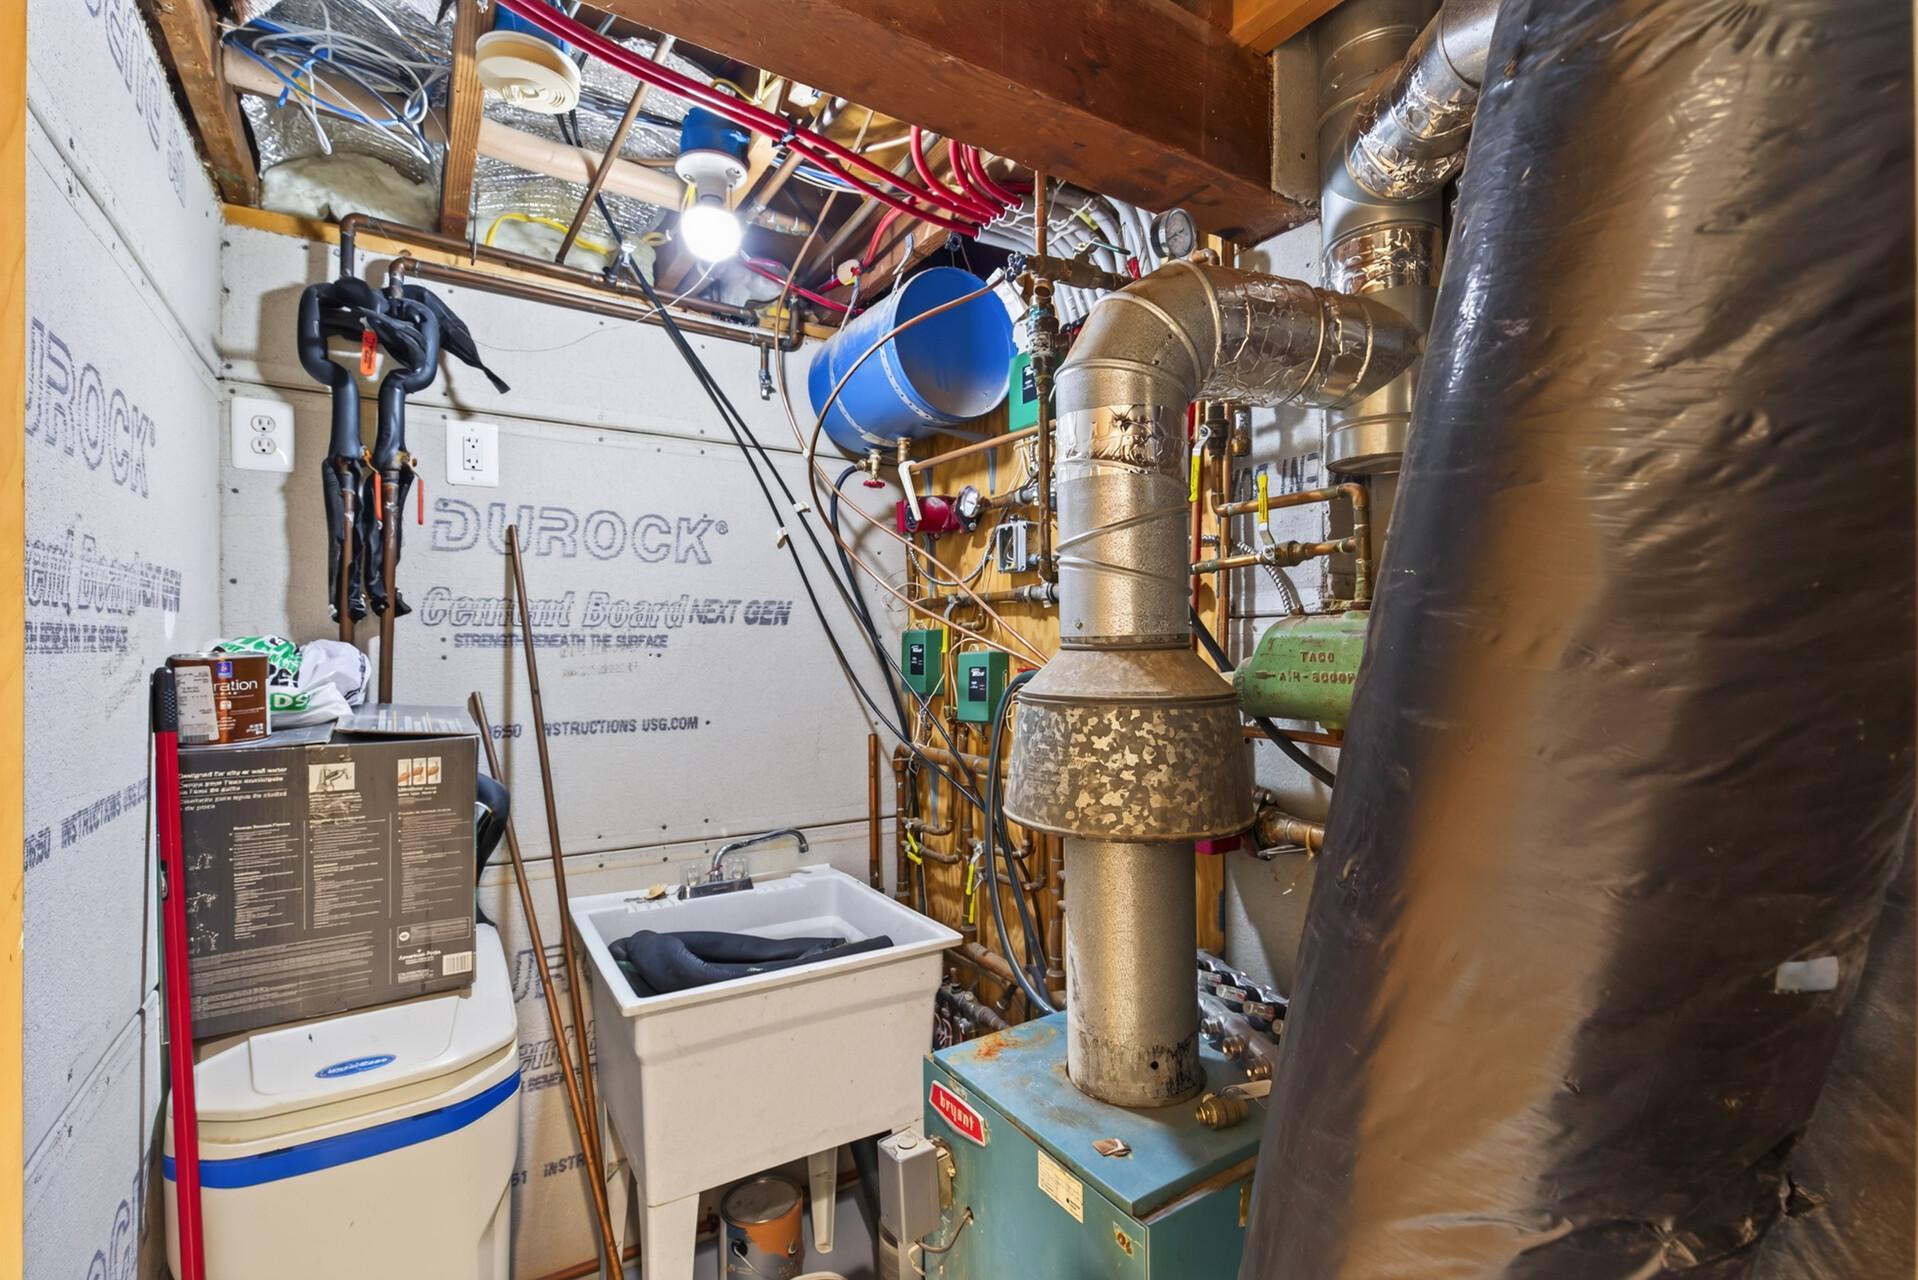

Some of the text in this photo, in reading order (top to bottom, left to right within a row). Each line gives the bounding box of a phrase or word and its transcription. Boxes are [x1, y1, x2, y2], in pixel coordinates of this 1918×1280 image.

[581, 591, 690, 629] Board
[689, 598, 742, 625] NEXT
[744, 600, 793, 626] GEN
[590, 634, 613, 648] THE
[616, 634, 669, 649] SURFACE
[214, 679, 258, 692] ration
[544, 718, 637, 737] NSTRUCTIONS
[641, 716, 699, 732] USG.COM
[938, 1090, 976, 1132] bryant
